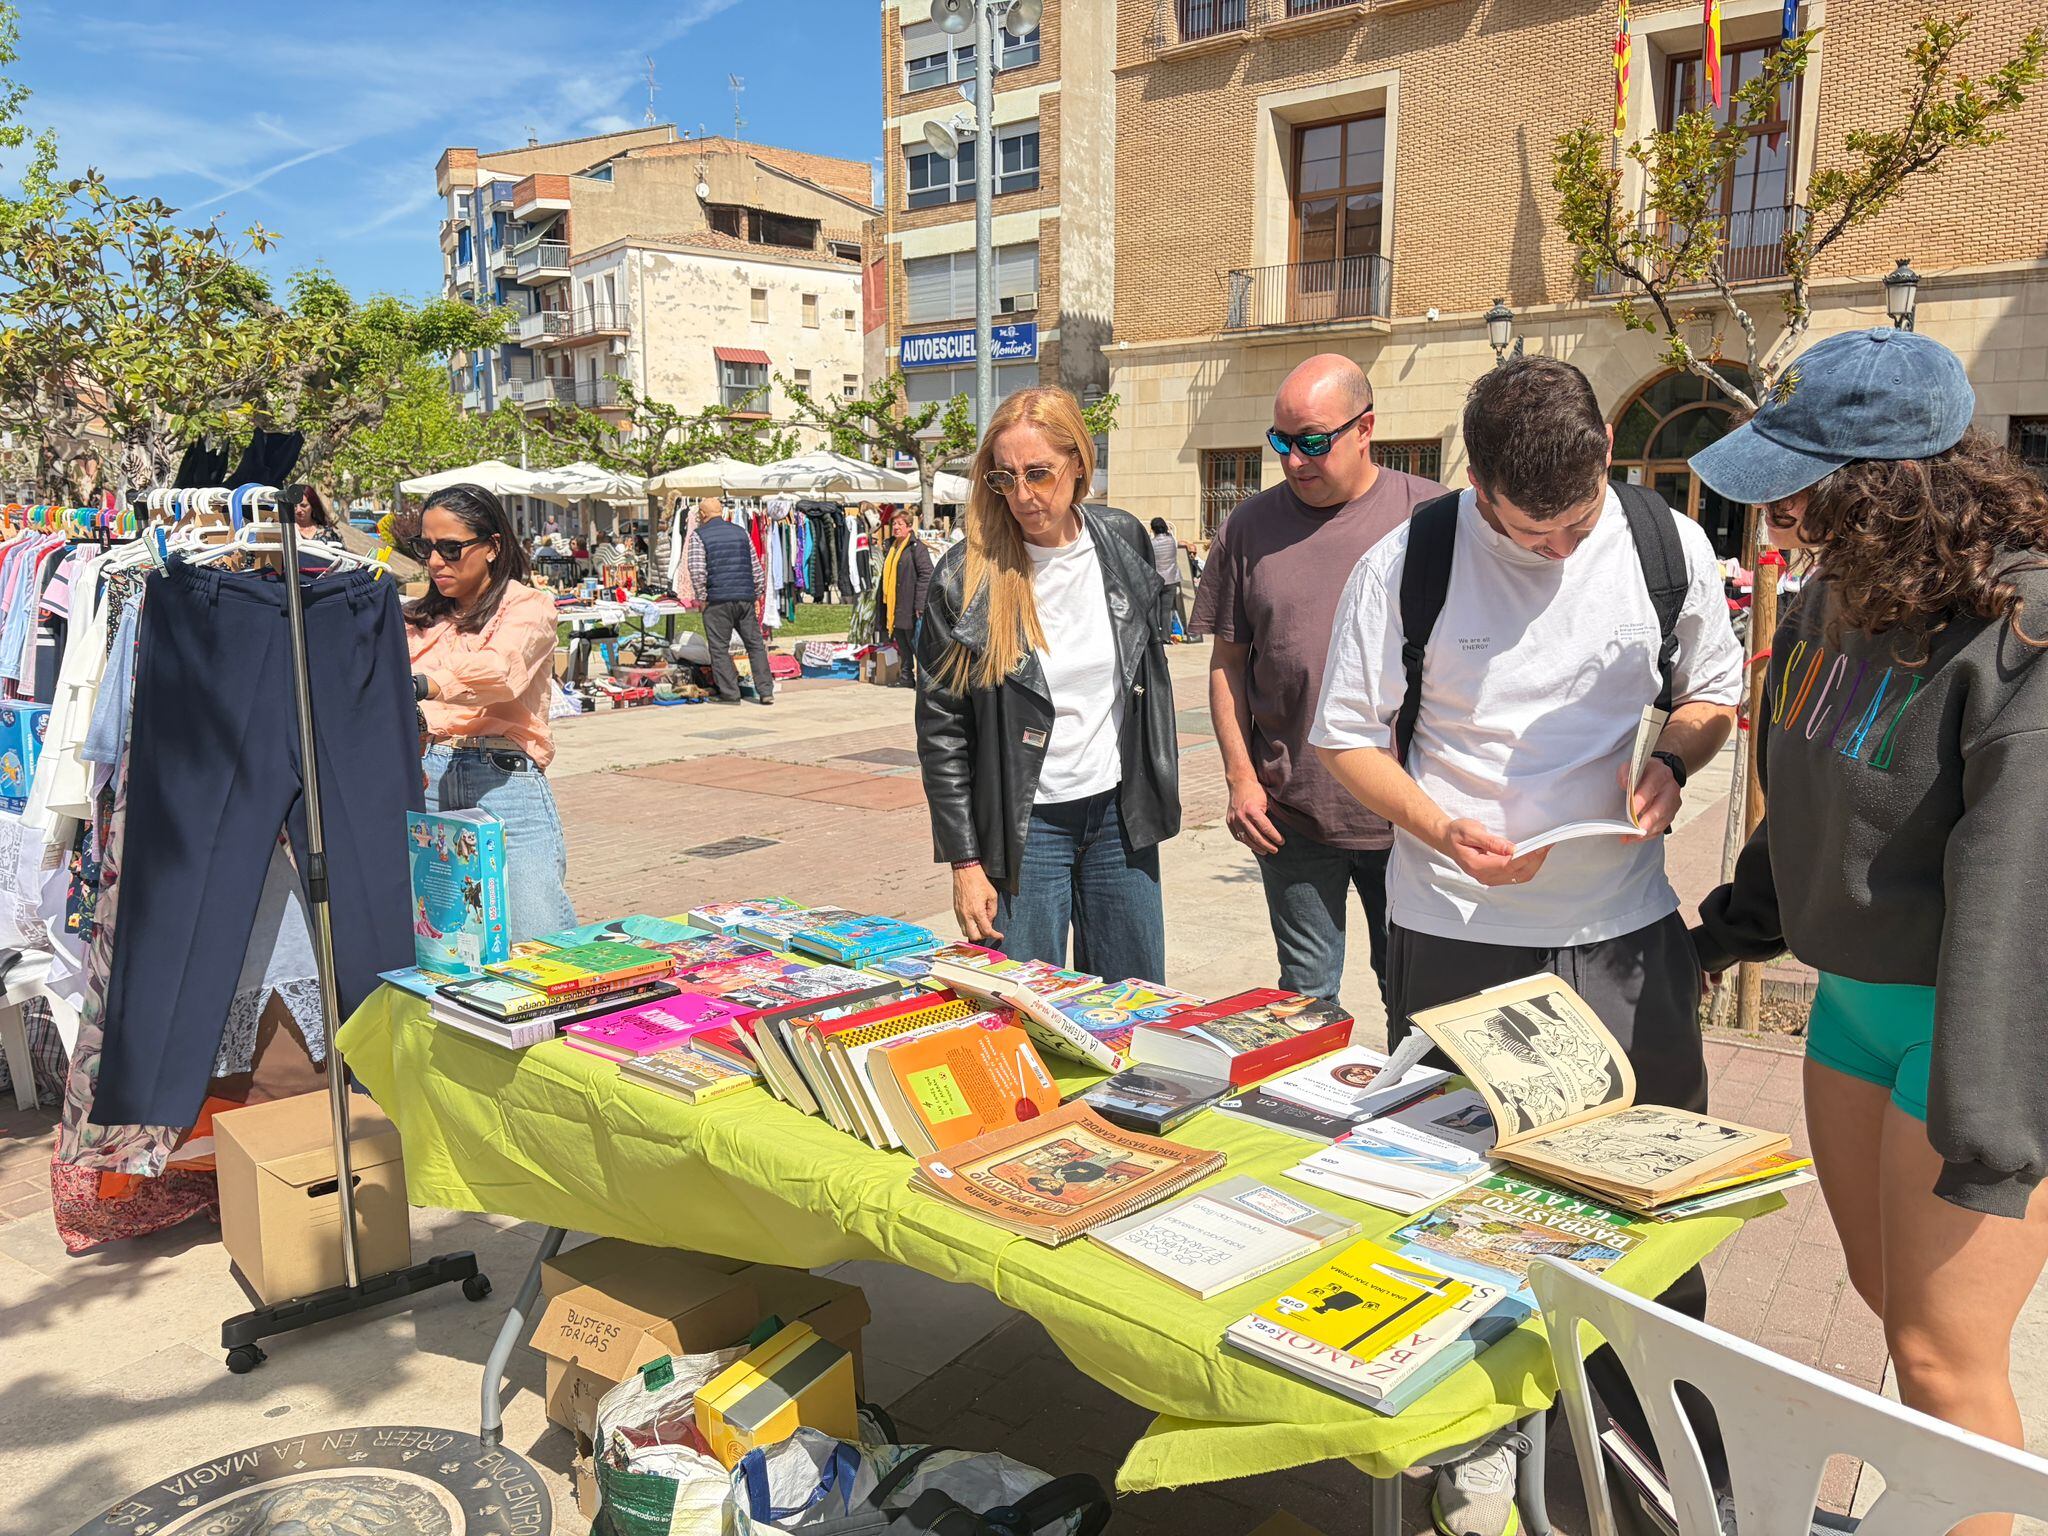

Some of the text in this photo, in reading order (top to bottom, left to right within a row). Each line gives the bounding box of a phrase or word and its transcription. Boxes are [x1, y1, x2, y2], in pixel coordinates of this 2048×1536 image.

[903, 334, 977, 362] AUTOESCUEL
[547, 992, 562, 1006] del
[563, 987, 596, 1002] parques
[597, 985, 611, 993] Los
[507, 1012, 538, 1022] universo
[517, 996, 546, 1012] cuerpo
[1060, 1018, 1089, 1045] CATEDRAL
[1090, 1040, 1099, 1051] LA
[1256, 1098, 1338, 1126] La sal en
[1080, 1116, 1117, 1142] GARDEL
[1117, 1136, 1147, 1152] HASTA
[1148, 1143, 1181, 1160] TANGO
[964, 1186, 1039, 1218] Javier Barreiro
[1503, 1182, 1613, 1220] GRAUS
[1481, 1197, 1632, 1249] BARBASTRO
[1125, 1234, 1198, 1266] LOS TOQUES
[1137, 1229, 1221, 1266] DE CAMPANAS
[1149, 1224, 1233, 1261] DE ZARAGOZA
[1330, 1265, 1354, 1281] PRIMA
[1354, 1276, 1369, 1287] TAN
[1391, 1291, 1408, 1302] UNA
[567, 1308, 621, 1338] BLISTERS
[560, 1324, 610, 1353] TORICAS
[161, 1429, 455, 1496] CREER EN LA MAGIA
[473, 1451, 540, 1536] ENCUENTRO
